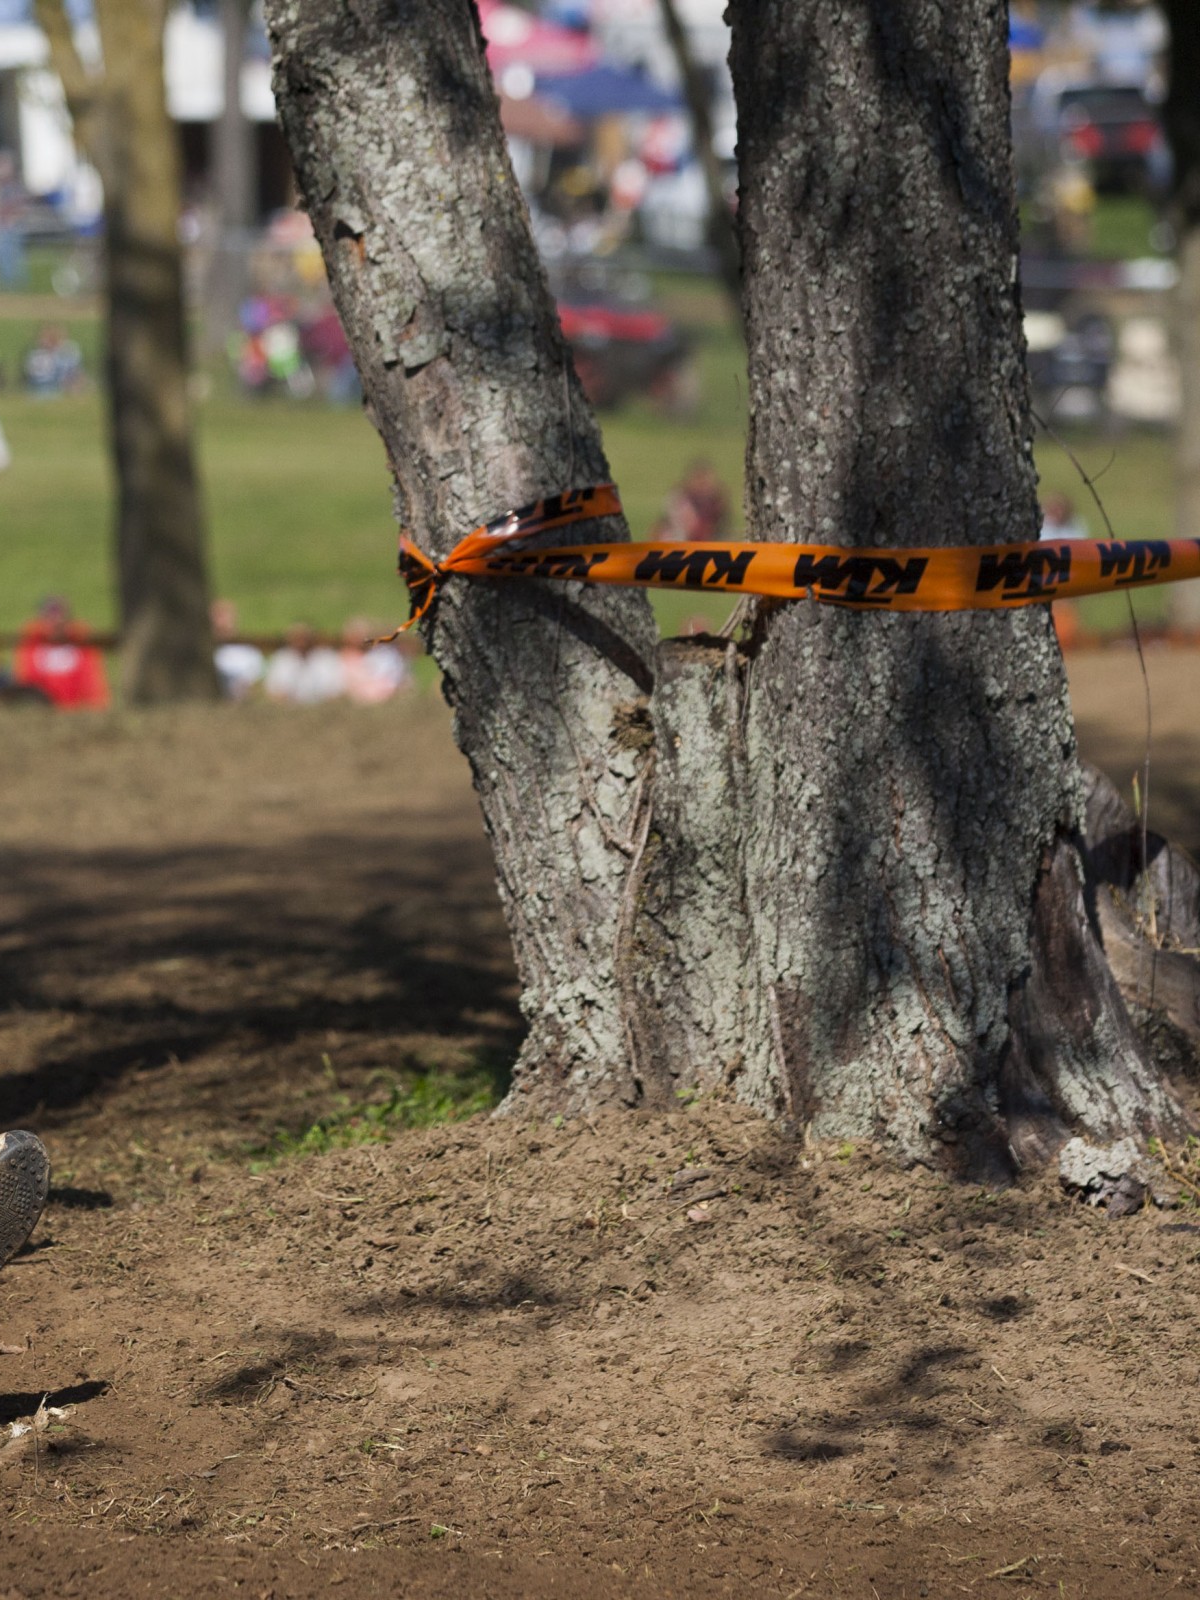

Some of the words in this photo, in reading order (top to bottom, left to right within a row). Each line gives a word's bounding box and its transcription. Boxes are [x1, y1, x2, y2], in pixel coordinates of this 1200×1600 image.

[794, 553, 929, 604] KTM
[976, 544, 1071, 600] KTM
[1097, 541, 1171, 584] KTM
